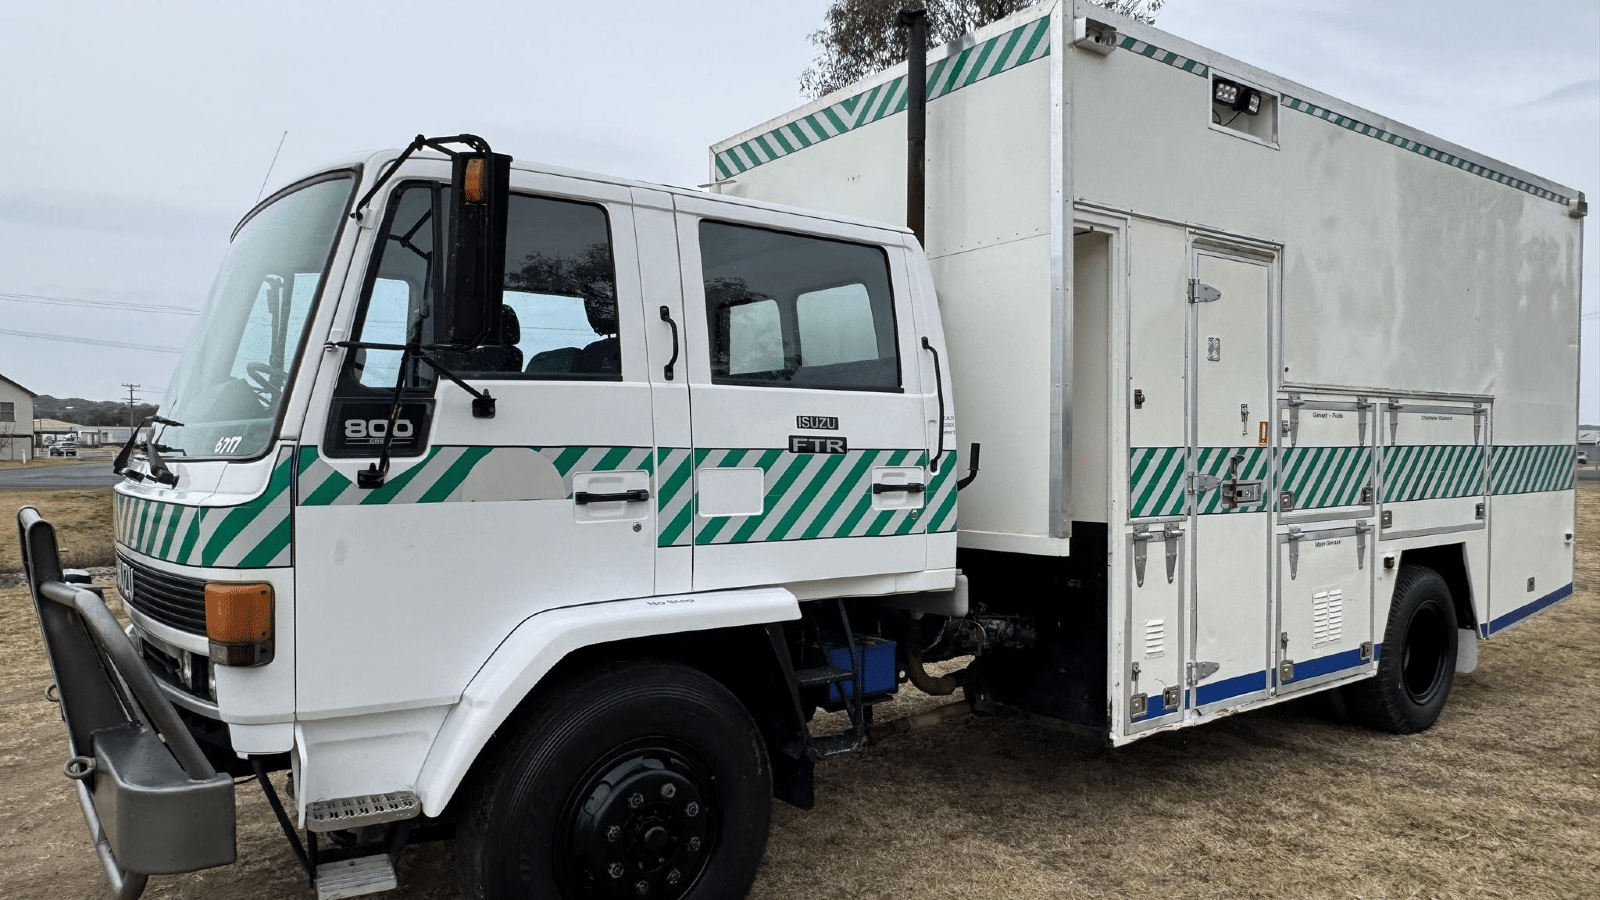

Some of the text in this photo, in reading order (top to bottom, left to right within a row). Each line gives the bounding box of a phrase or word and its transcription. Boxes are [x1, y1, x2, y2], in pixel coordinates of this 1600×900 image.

[344, 419, 414, 438] 800
[797, 416, 837, 429] ISUZU
[792, 437, 845, 453] FTR
